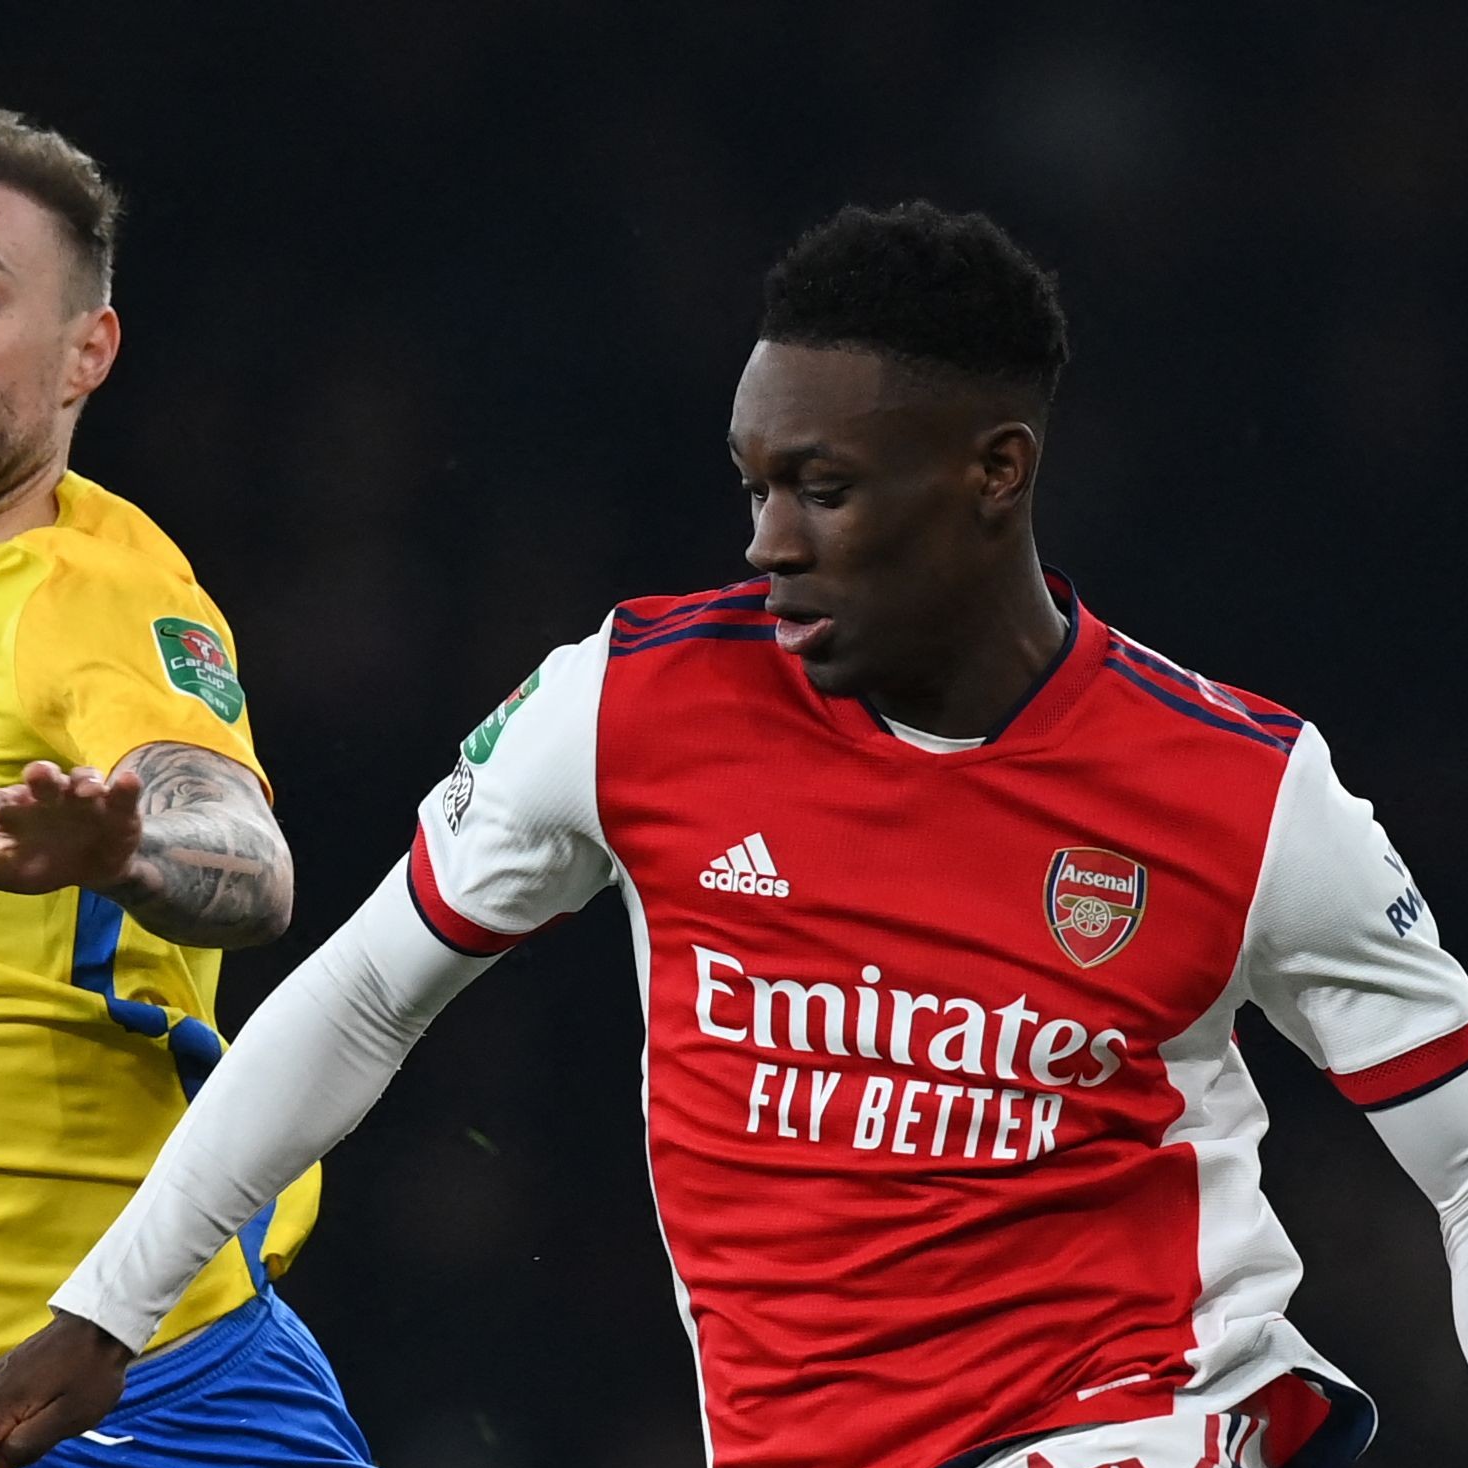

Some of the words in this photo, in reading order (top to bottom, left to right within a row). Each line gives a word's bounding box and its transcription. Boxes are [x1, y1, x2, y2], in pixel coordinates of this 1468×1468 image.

[195, 668, 225, 690] Cup
[699, 866, 790, 898] adidas
[1060, 862, 1134, 895] Arsenal
[691, 944, 1128, 1088] Emirates
[746, 1063, 842, 1143] FLY
[852, 1076, 1063, 1161] BETTER
